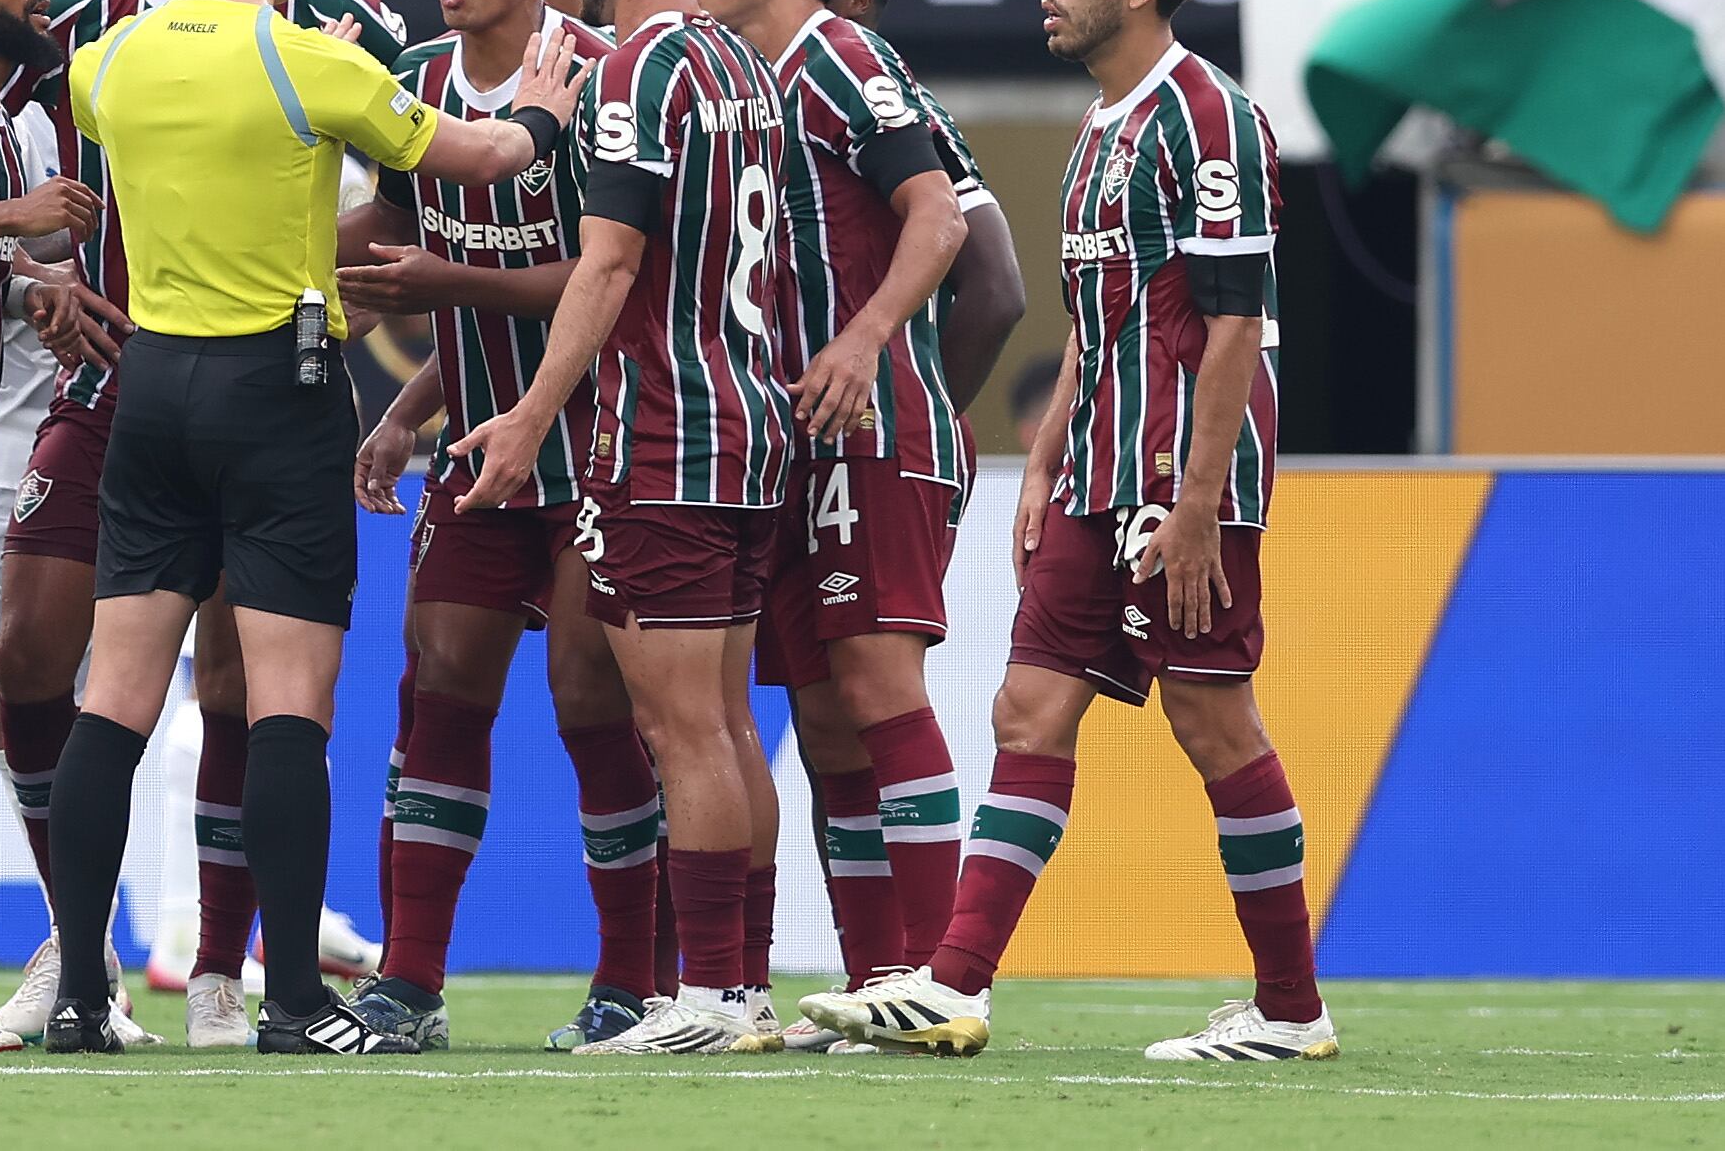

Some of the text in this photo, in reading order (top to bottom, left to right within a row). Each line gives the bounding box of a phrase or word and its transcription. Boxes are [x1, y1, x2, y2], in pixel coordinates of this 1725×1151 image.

[166, 21, 219, 34] MAKKELIE
[862, 75, 906, 118] S
[596, 101, 636, 151] S
[1196, 159, 1240, 210] S
[422, 205, 558, 251] SUPERBET
[730, 163, 771, 337] 8
[1061, 226, 1128, 261] ERBET
[807, 462, 860, 555] 14
[822, 591, 859, 607] umbro
